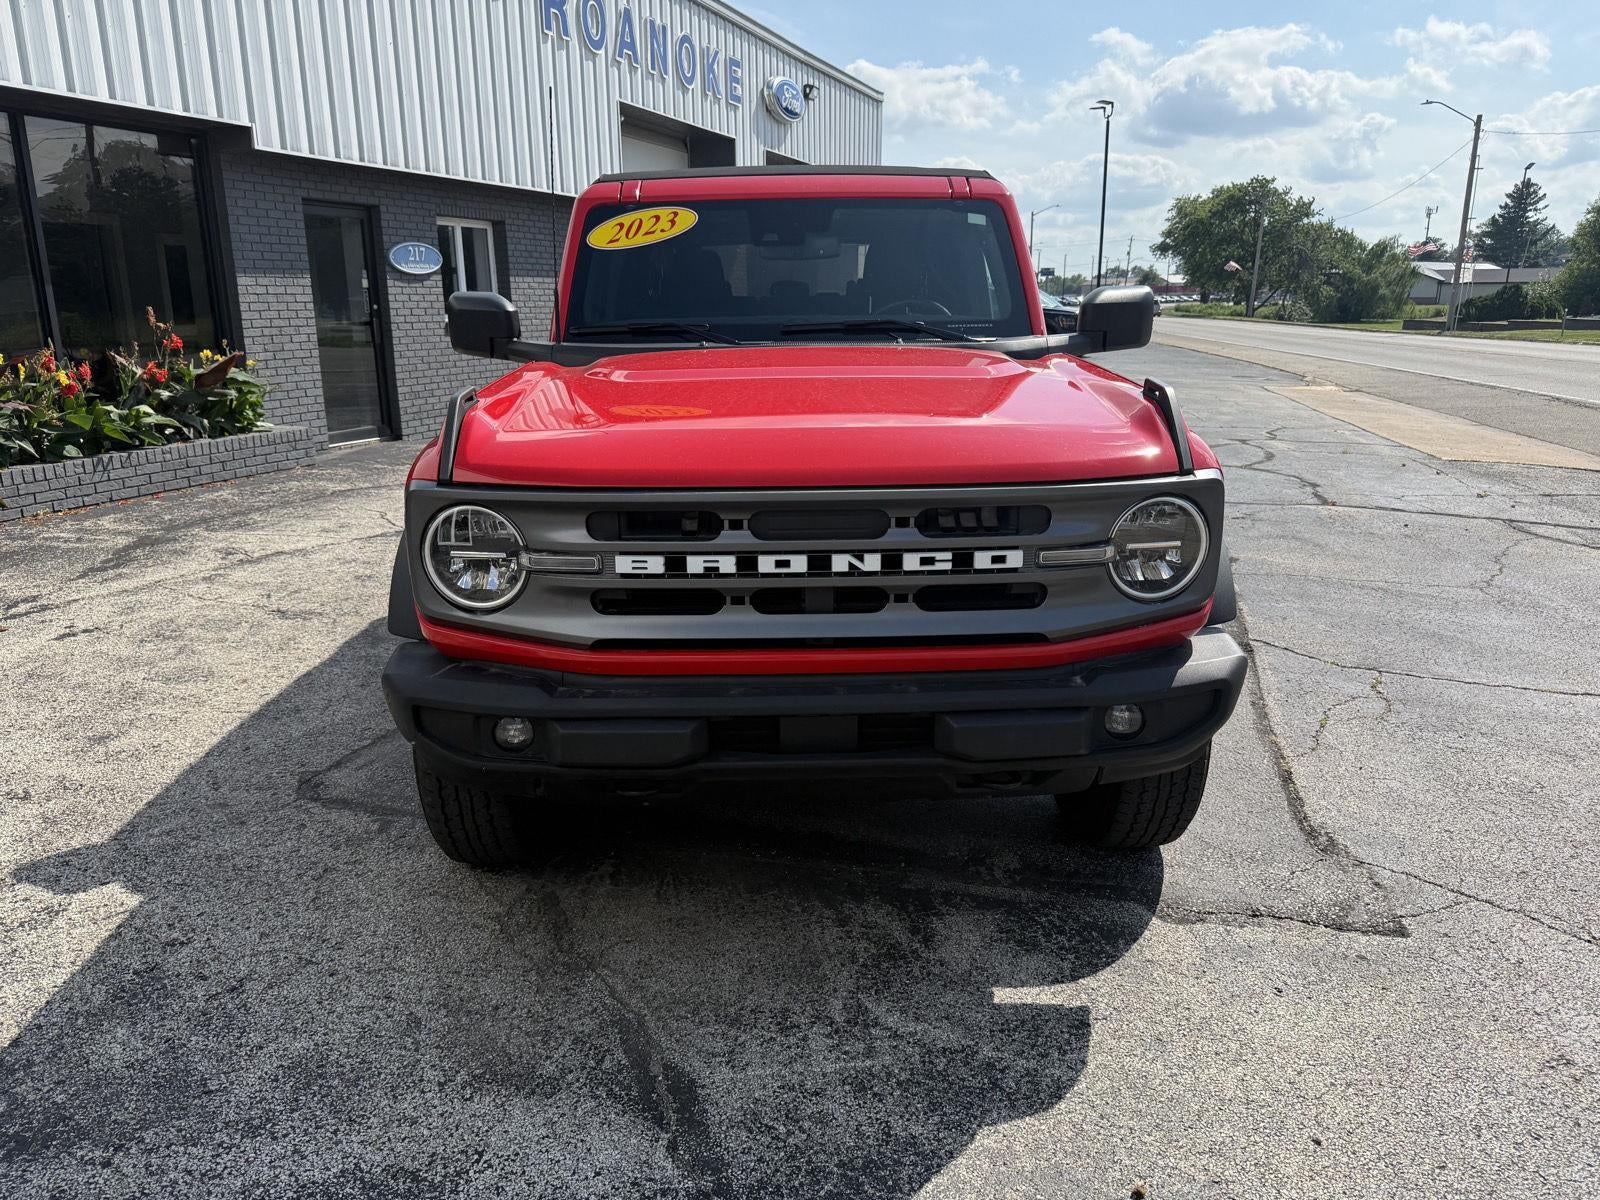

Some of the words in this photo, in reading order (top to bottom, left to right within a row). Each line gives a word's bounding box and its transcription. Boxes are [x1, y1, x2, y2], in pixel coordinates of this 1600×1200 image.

[543, 0, 742, 106] ROANOKE
[781, 85, 802, 114] Ford
[607, 211, 679, 244] 2023
[408, 246, 426, 261] 217
[614, 549, 1024, 575] BRONCO
